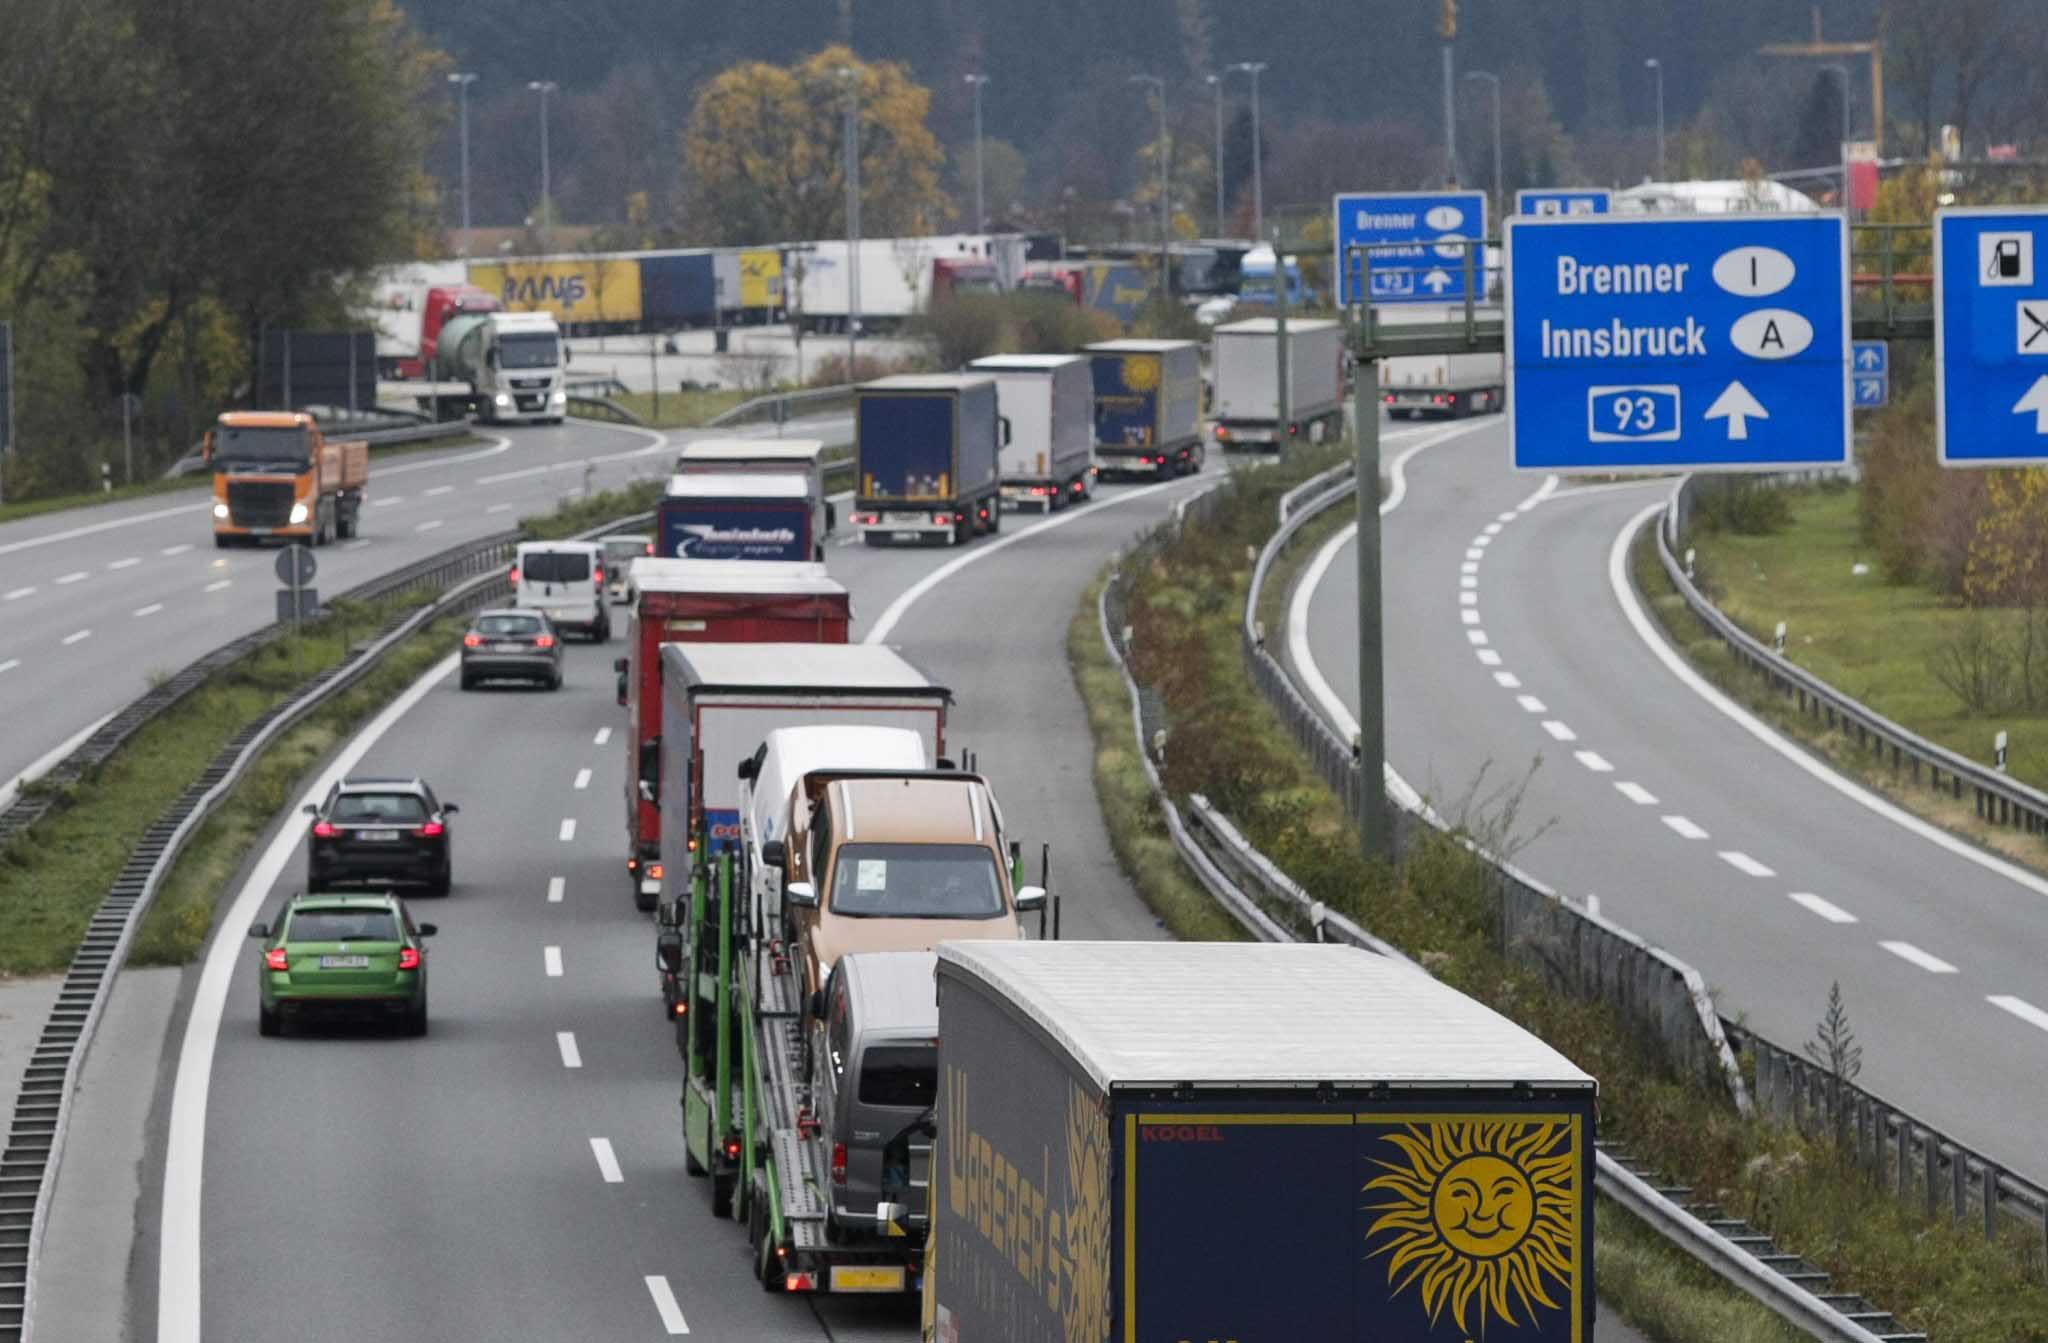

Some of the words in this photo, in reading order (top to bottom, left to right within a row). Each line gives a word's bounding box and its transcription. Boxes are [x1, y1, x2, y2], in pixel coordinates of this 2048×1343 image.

[1357, 210, 1416, 230] Brenner
[1557, 255, 1688, 294] Brenner
[1750, 256, 1757, 286] I
[1542, 316, 1707, 358] Innsbruck
[1760, 319, 1784, 349] A
[1613, 397, 1656, 430] 93
